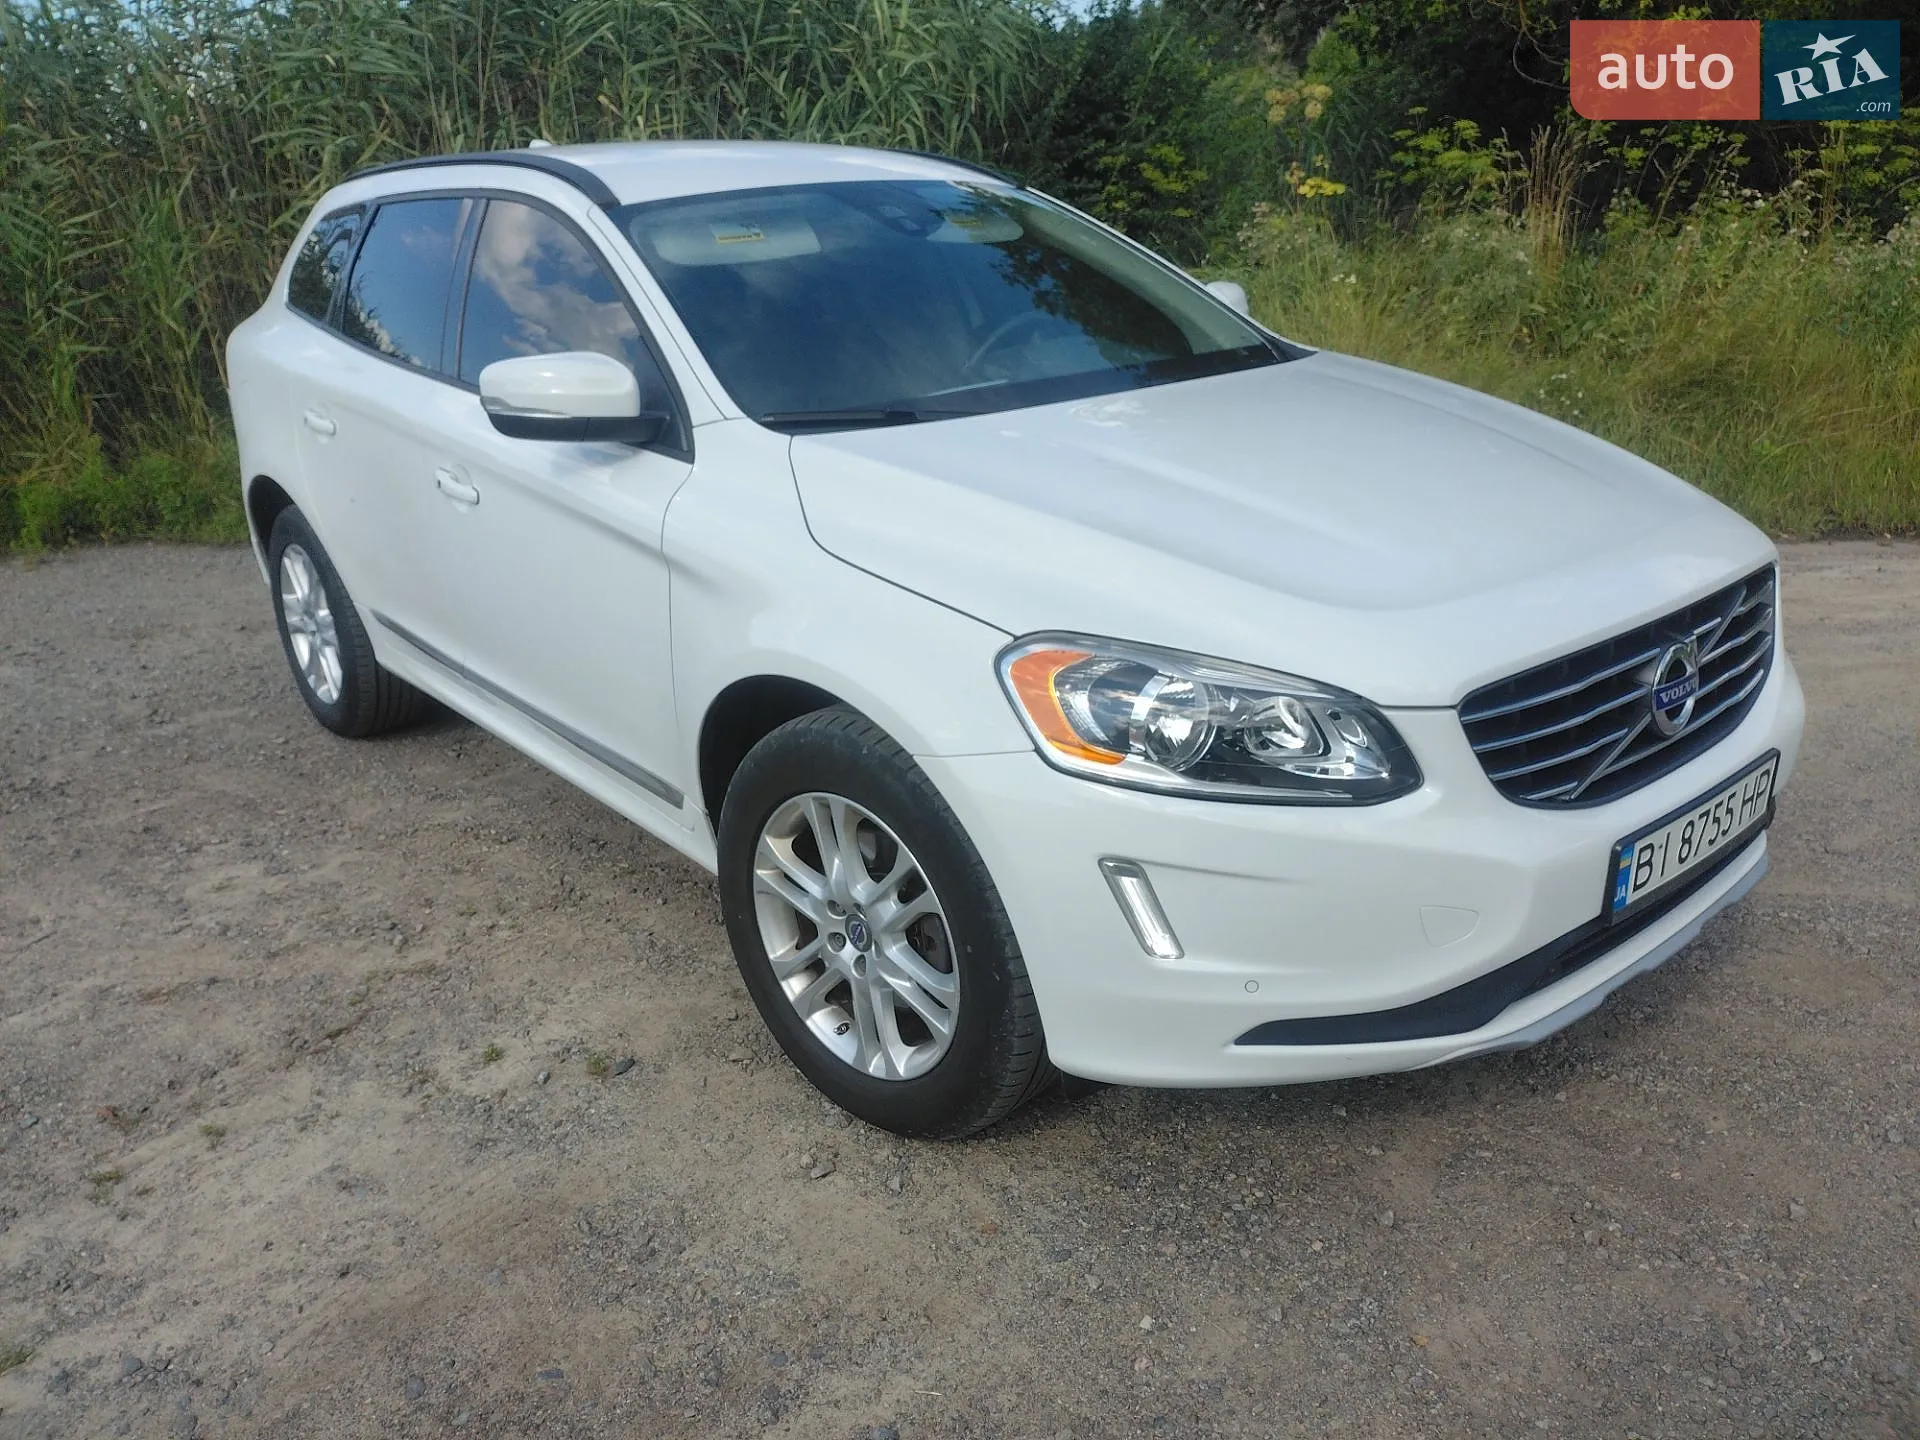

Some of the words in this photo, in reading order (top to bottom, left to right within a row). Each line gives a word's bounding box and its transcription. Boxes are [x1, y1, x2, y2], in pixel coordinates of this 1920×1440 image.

[1660, 676, 1697, 704] VOLVO
[1632, 831, 1671, 894] BI
[1678, 791, 1737, 865] 8755
[1738, 768, 1771, 827] HP
